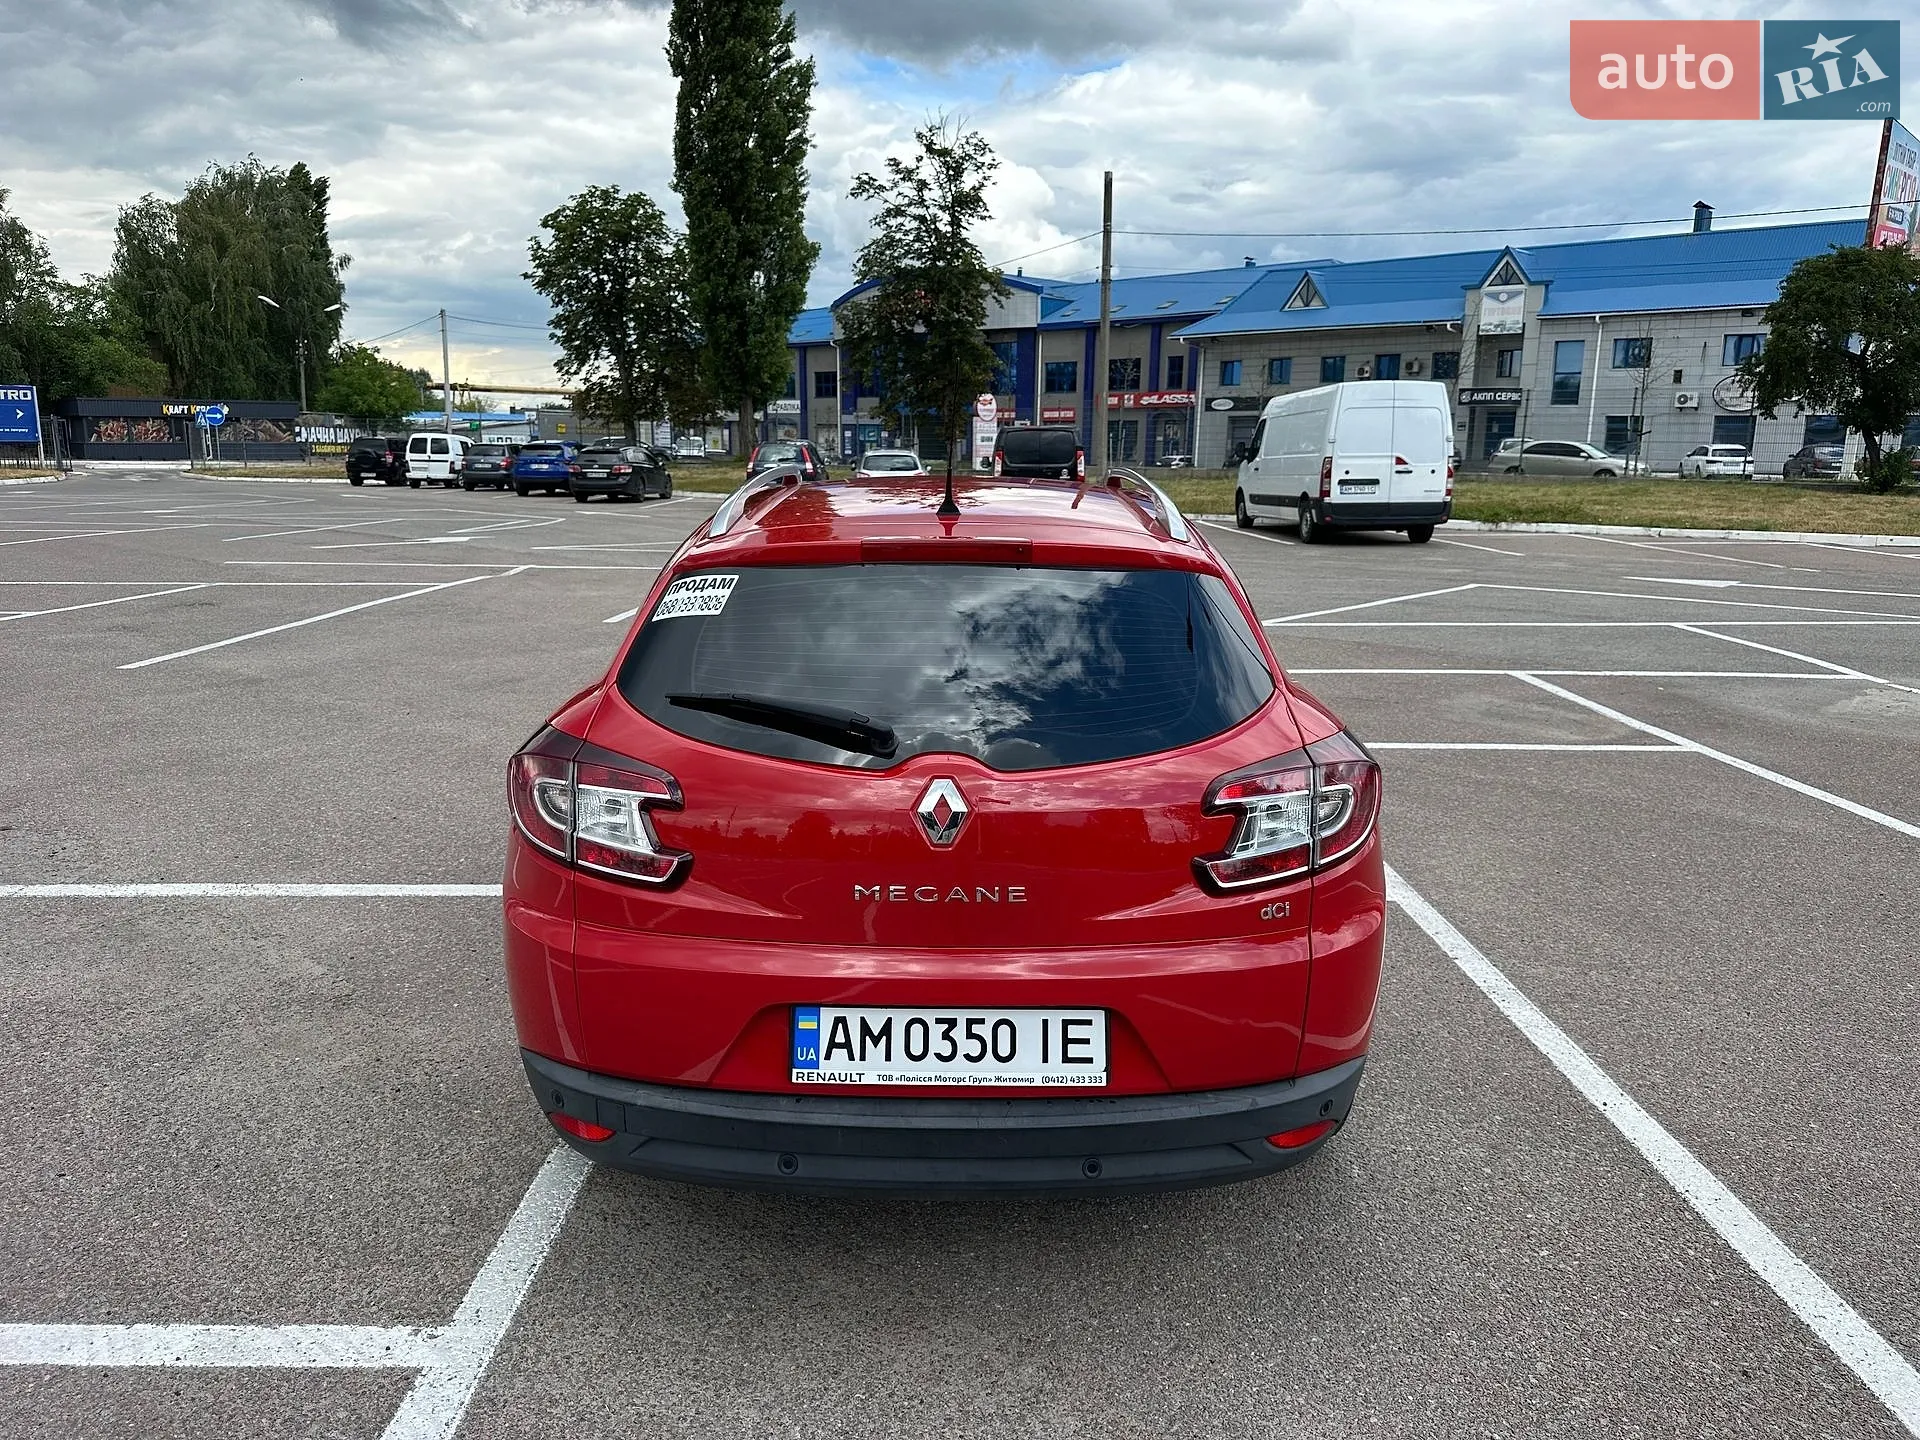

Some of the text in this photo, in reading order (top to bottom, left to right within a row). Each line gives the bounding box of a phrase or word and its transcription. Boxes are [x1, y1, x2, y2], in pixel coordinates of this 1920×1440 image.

[1472, 392, 1494, 401] АКПП
[162, 404, 188, 415] KRAFT
[667, 578, 736, 596] ПРОДАМ
[854, 884, 1028, 903] MEGANE
[1260, 901, 1290, 921] dCi
[823, 1015, 1094, 1065] AM 0350 IE
[797, 1049, 816, 1062] UA
[795, 1071, 865, 1083] RENAULT
[876, 1074, 1035, 1085] ТОВ «Полісся Моторс Груп» Житомир
[1041, 1075, 1103, 1085] (0412) 433 333
